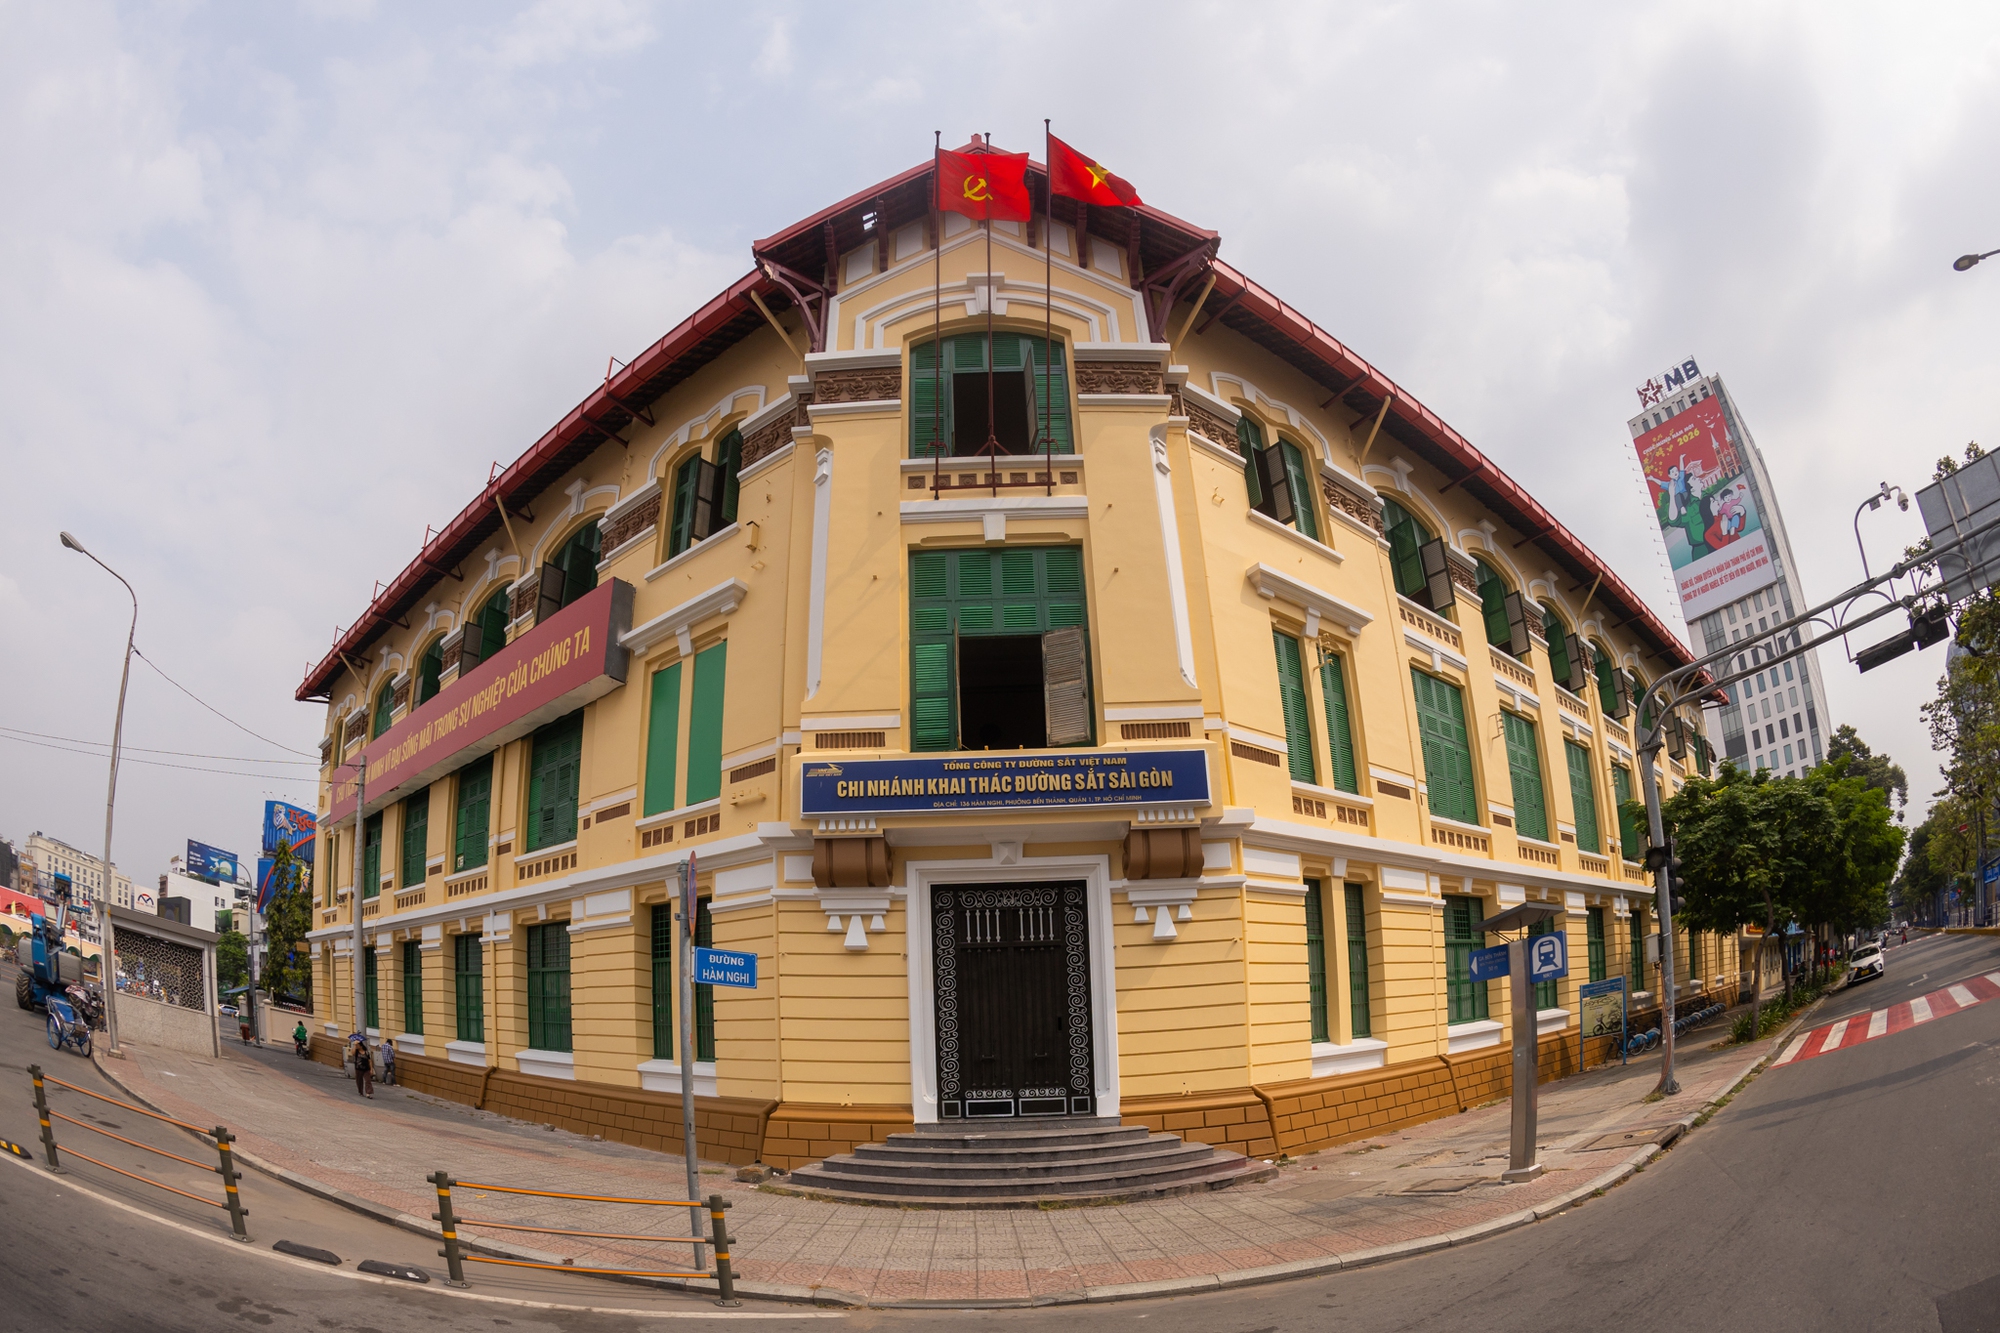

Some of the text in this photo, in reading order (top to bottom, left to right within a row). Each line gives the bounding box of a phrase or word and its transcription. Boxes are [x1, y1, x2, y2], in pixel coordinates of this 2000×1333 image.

[1664, 360, 1699, 392] MB
[1677, 428, 1700, 446] 2026
[402, 732, 419, 762] SỐNG
[418, 722, 432, 752] MÃI
[434, 707, 459, 742] TRONG
[459, 697, 472, 728] SỰ
[471, 676, 506, 719] NGHIỆP
[507, 660, 528, 698] CỦA
[530, 641, 571, 684] CHÚNG
[574, 626, 590, 659] TA
[944, 756, 1127, 771] TỔNG CÔNG TY ĐƯỜNG SẮT VIỆT NAM
[837, 766, 1173, 798] CHI NHÁNH KHAI THÁC ĐƯỜNG SẮT SÀI GÒN
[1033, 796, 1044, 804] BẾN
[1069, 796, 1087, 804] QUẬN
[709, 954, 744, 966] ĐƯỜNG
[702, 966, 749, 984] HÀM NGHI
